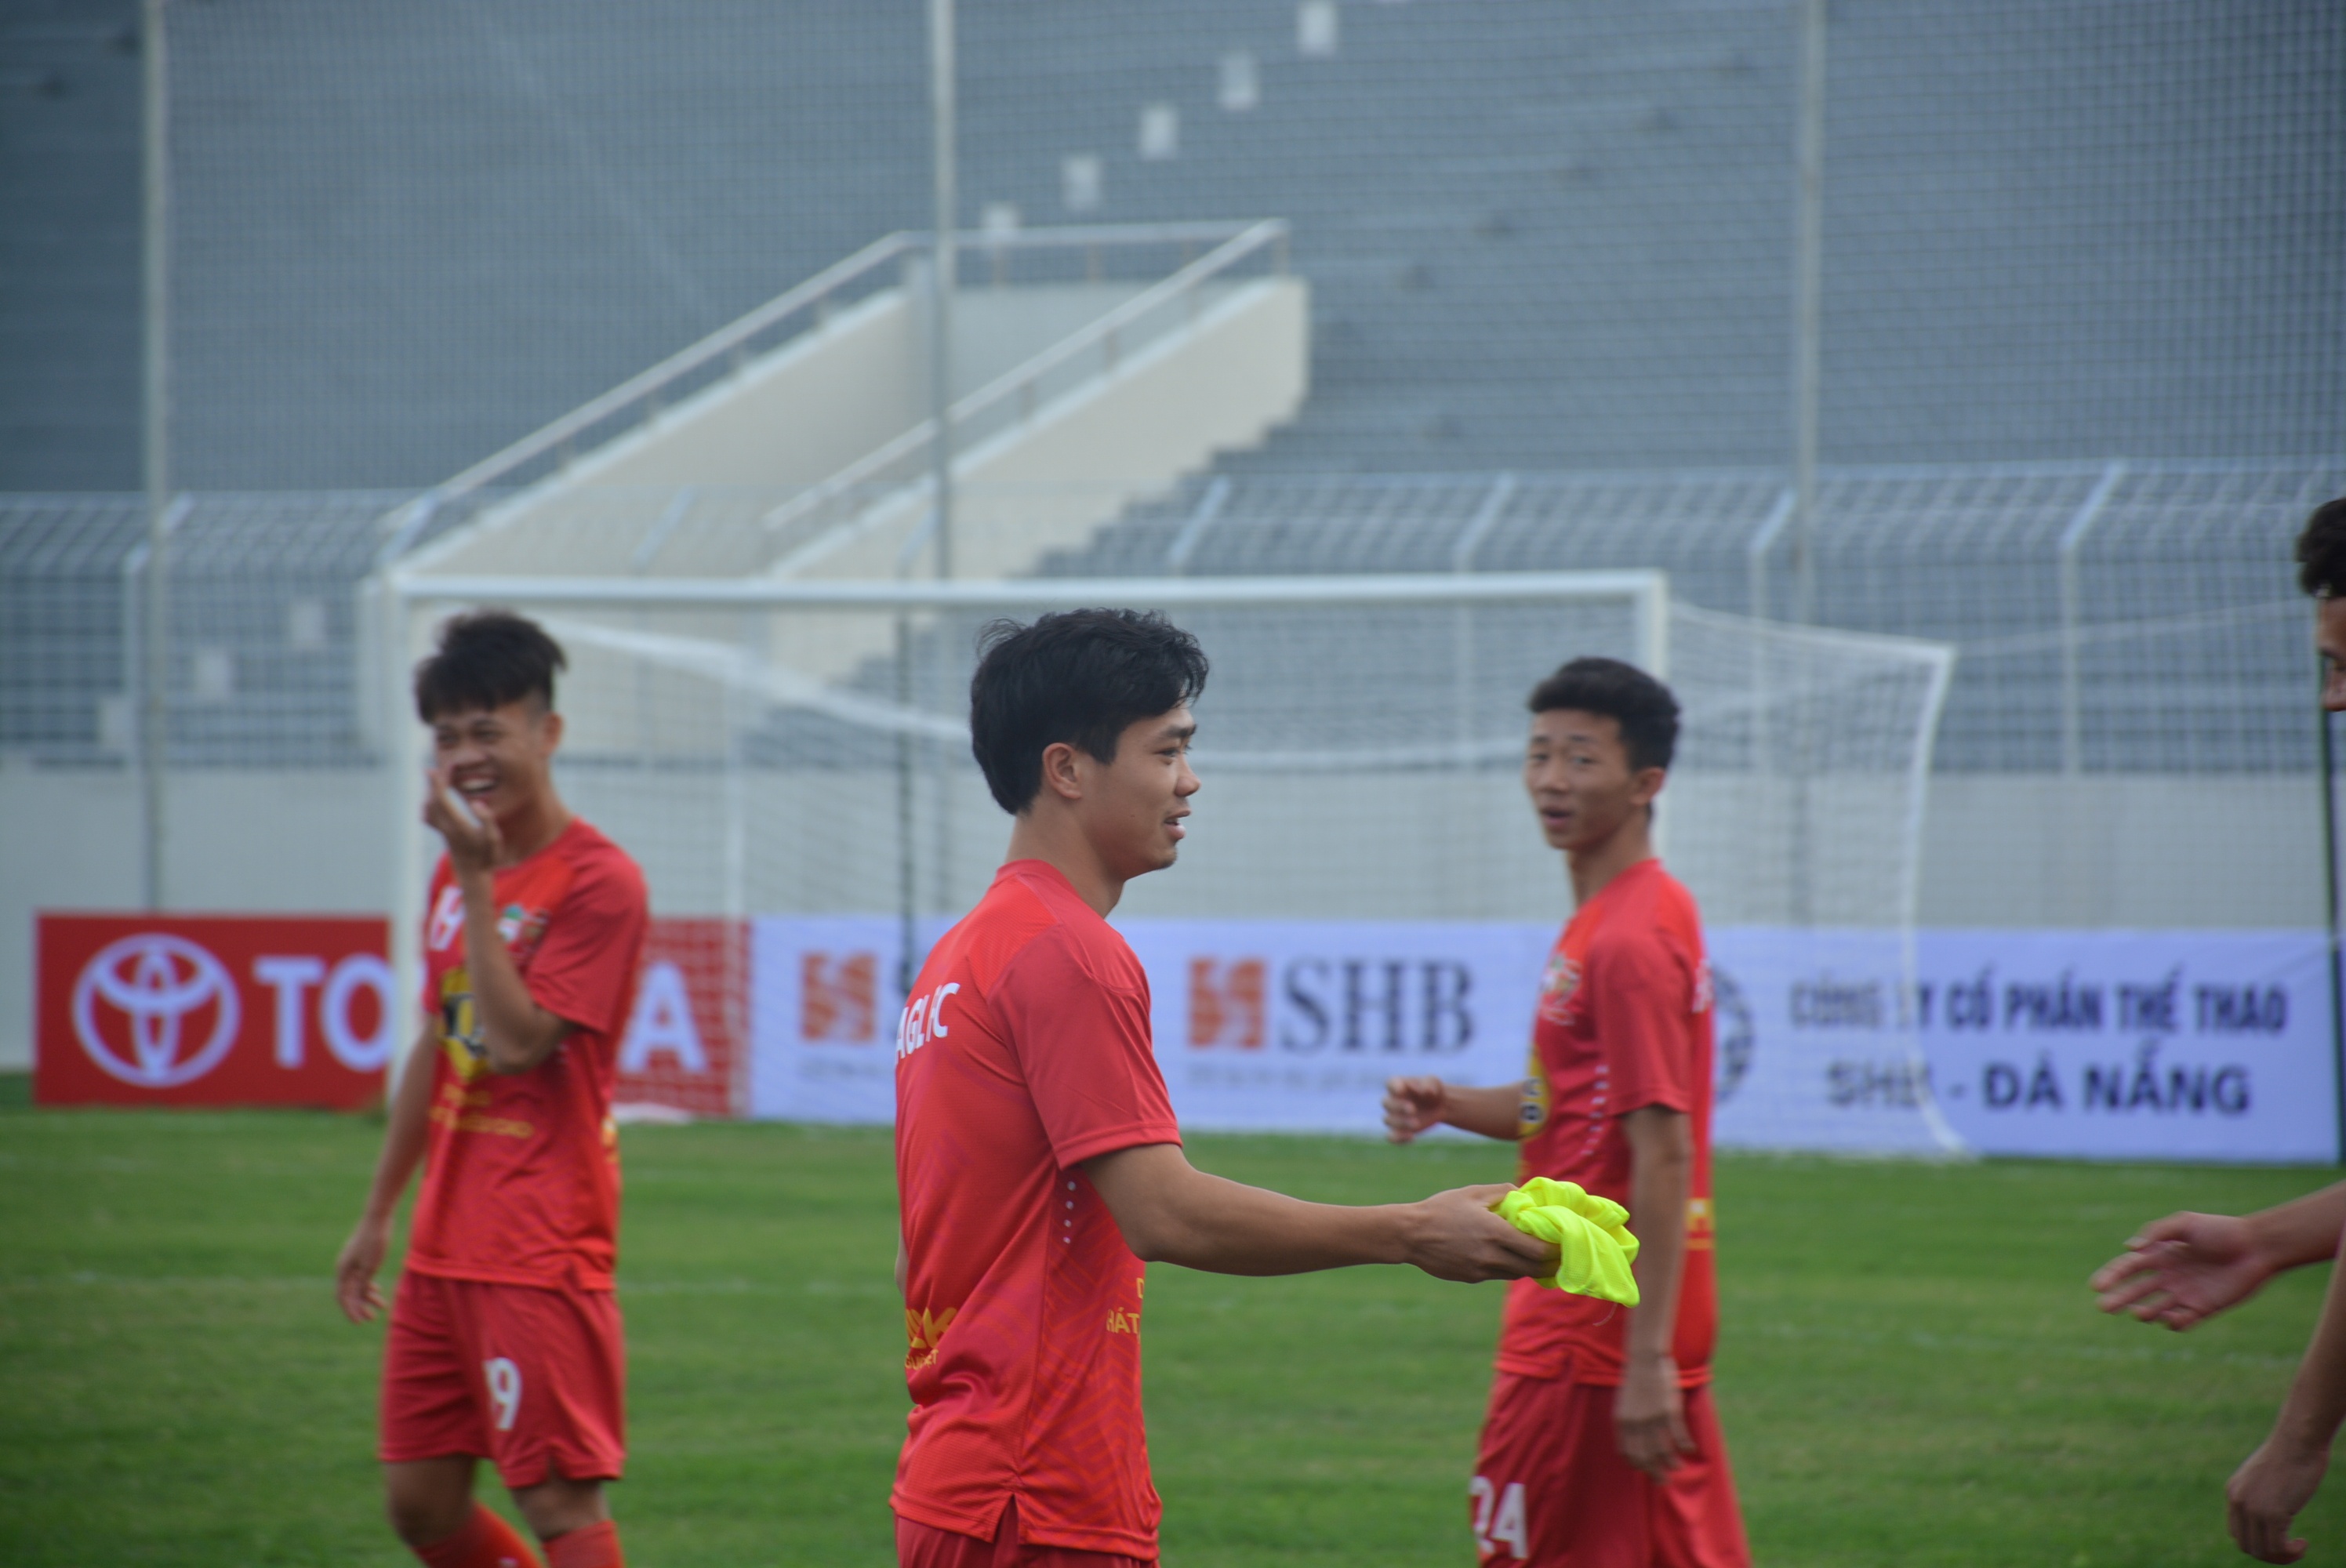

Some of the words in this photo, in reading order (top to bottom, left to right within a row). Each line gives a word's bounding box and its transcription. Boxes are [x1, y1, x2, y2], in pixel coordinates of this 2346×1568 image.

[1278, 957, 1476, 1054] SHB
[2194, 980, 2289, 1038] THAO
[1469, 1475, 1529, 1559] 24
